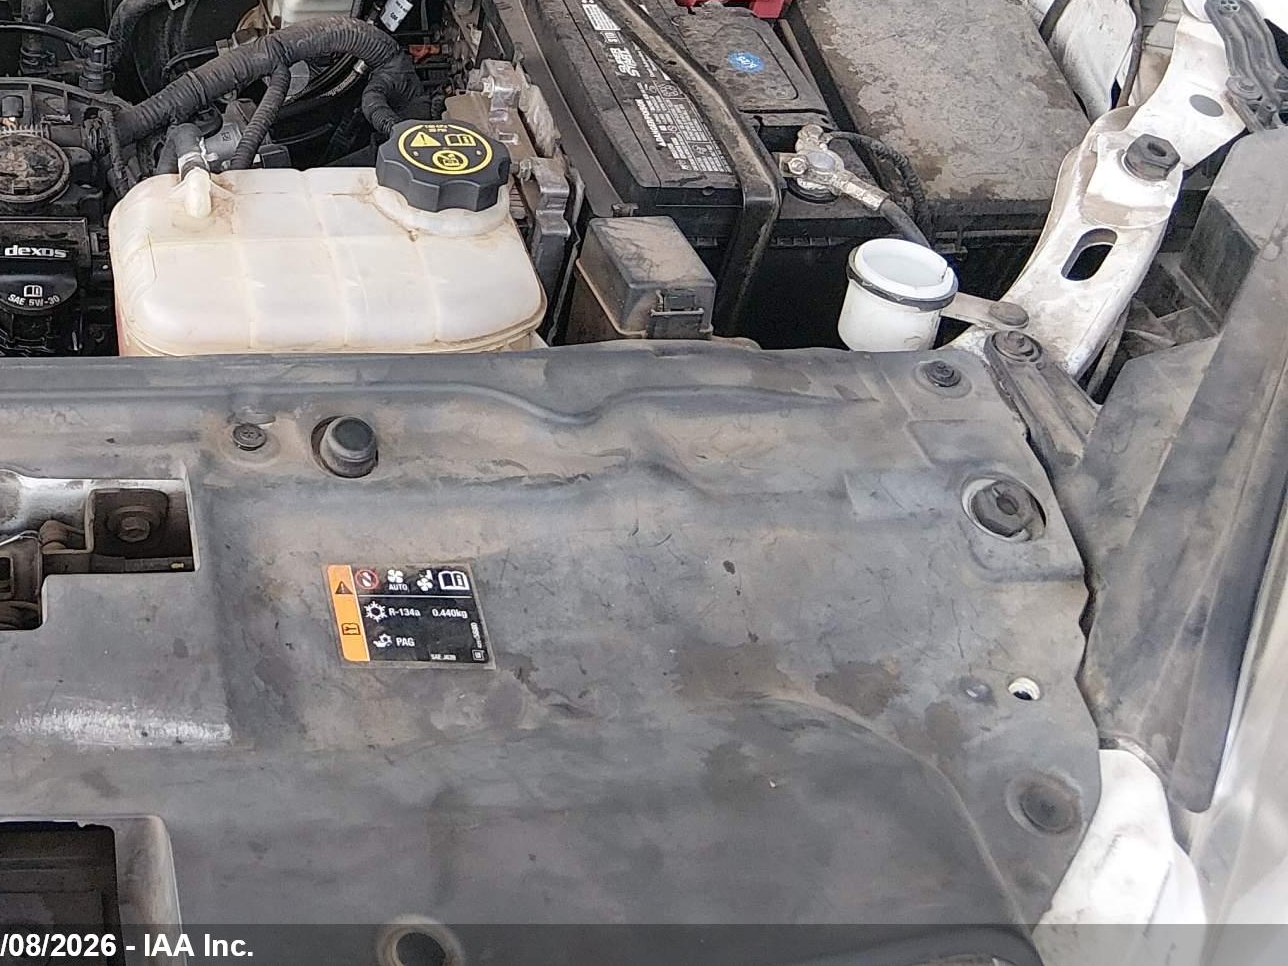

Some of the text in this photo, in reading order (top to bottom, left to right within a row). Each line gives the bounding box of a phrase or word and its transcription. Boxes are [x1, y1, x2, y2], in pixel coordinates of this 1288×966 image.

[4, 244, 67, 258] dexos
[7, 294, 60, 307] SAE 5W-30
[388, 583, 408, 591] AUTO
[388, 608, 468, 619] R-134a 0.440kg
[396, 637, 416, 647] PAG
